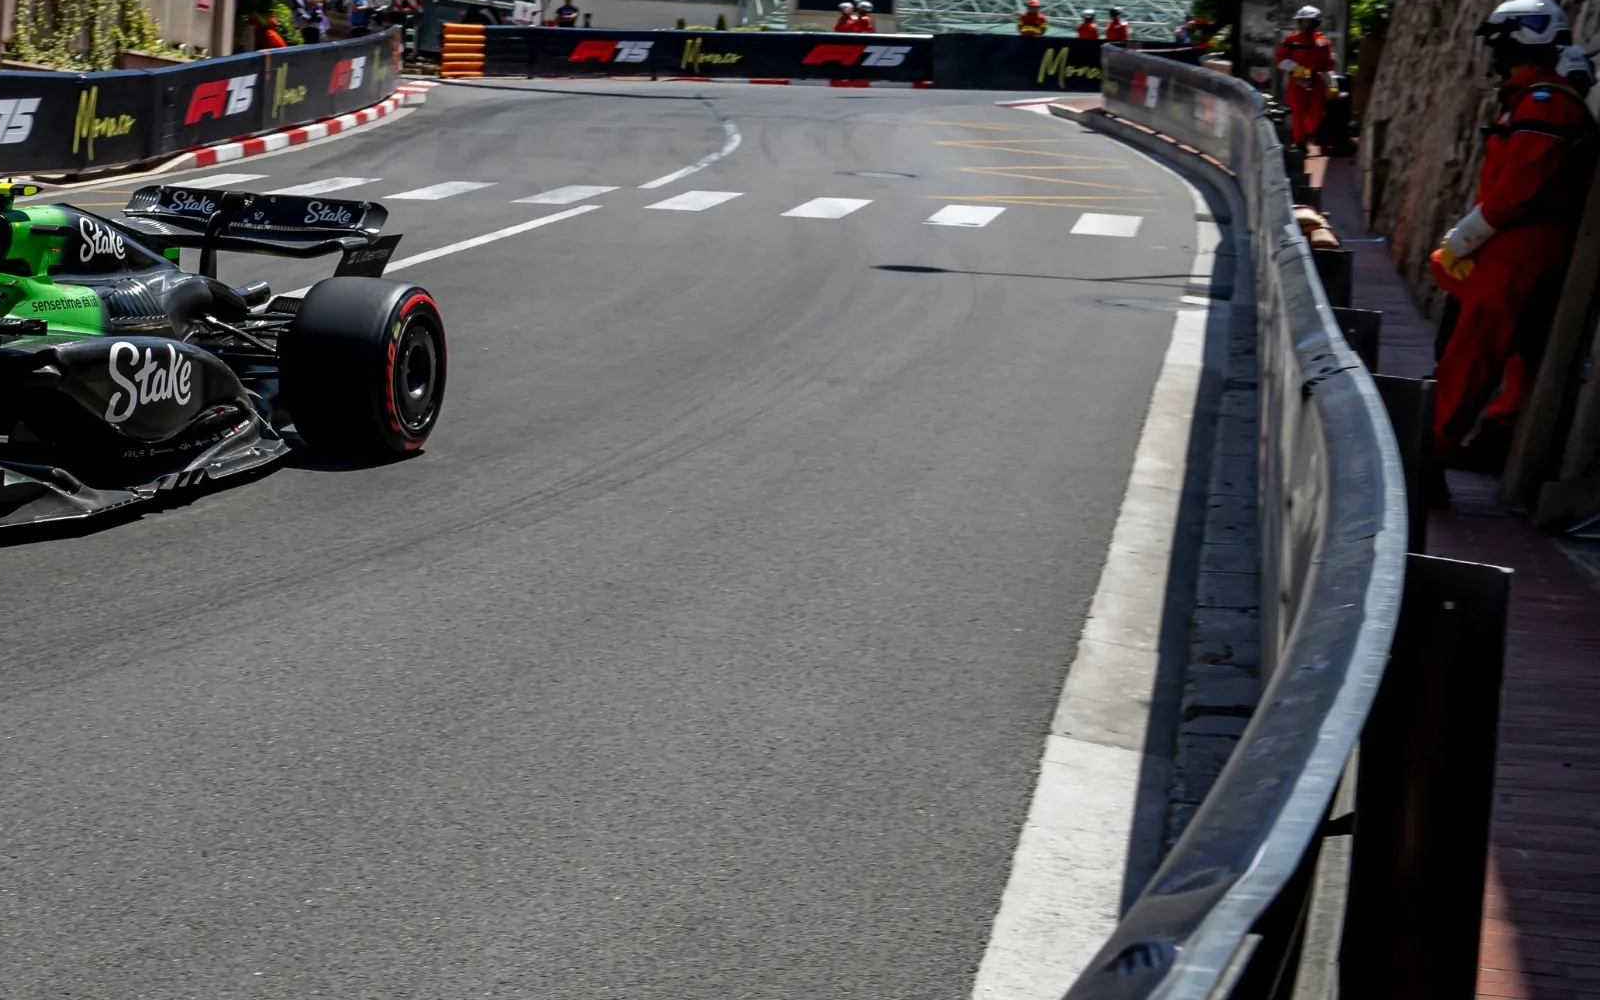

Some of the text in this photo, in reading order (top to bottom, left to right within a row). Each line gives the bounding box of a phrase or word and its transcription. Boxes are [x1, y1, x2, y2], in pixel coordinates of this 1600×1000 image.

[681, 38, 742, 71] Monaco
[73, 85, 136, 160] Monaco
[168, 191, 216, 215] Stake
[303, 201, 352, 225] Stake
[79, 216, 126, 263] Stake
[32, 297, 82, 313] sensetime
[105, 341, 192, 423] Stake
